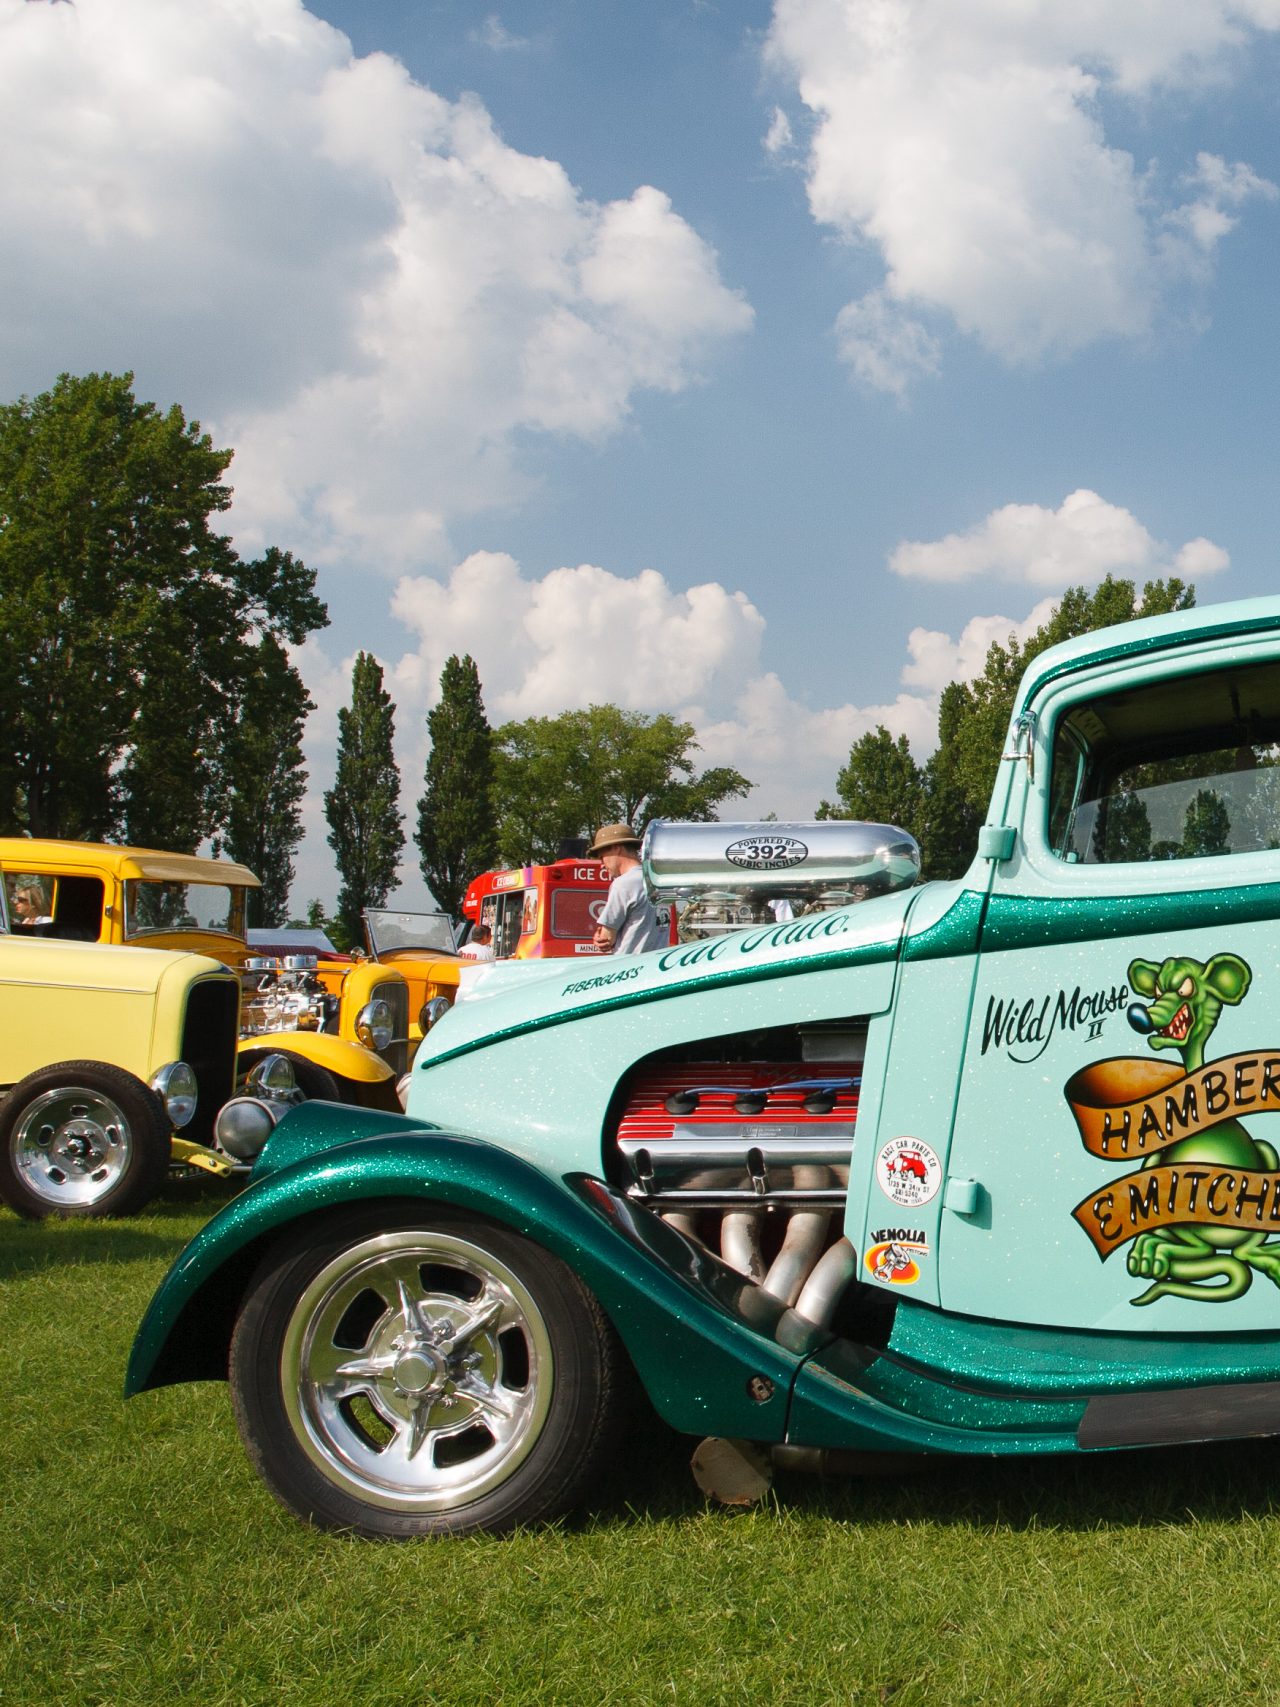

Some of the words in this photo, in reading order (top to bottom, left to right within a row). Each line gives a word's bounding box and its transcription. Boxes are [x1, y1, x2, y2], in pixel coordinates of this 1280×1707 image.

[737, 837, 782, 848] POWERED
[784, 840, 798, 848] BY
[747, 845, 787, 860] 392
[732, 855, 763, 869] CUBIC
[764, 854, 801, 869] INCHES
[574, 868, 595, 880] ICE
[562, 965, 644, 997] FIBERGLASS
[981, 994, 1052, 1056] Wild
[1030, 984, 1129, 1055] Mouse
[896, 1140, 908, 1149] CAR
[911, 1141, 931, 1157] PARTS
[870, 1228, 926, 1244] VENOLIA
